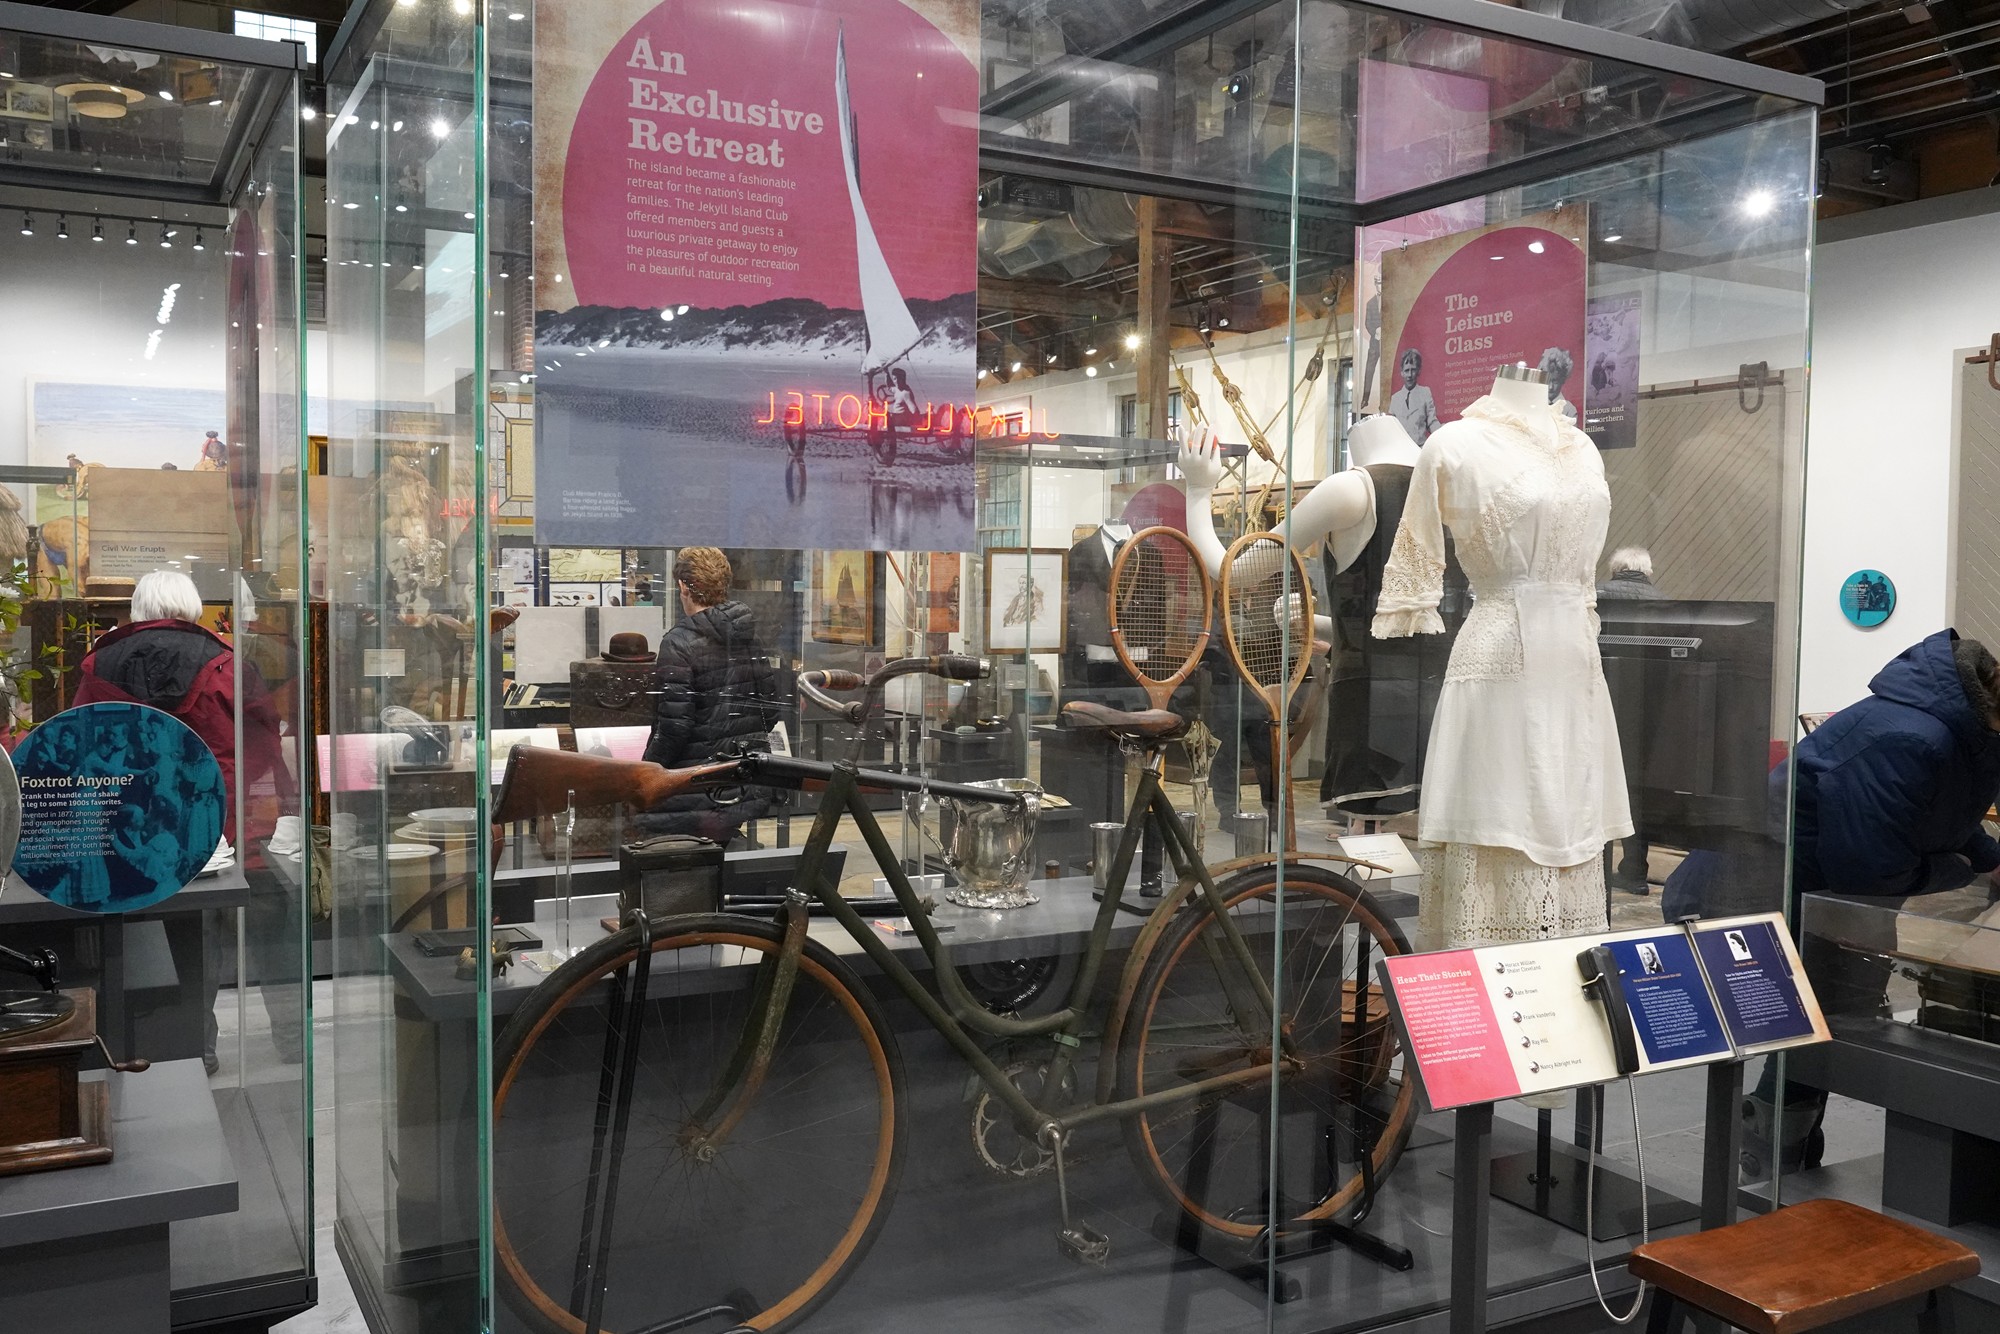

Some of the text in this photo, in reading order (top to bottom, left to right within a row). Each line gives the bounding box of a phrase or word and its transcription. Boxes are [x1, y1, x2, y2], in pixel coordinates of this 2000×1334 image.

[626, 38, 687, 75] An
[628, 77, 824, 134] Exclusive
[628, 118, 785, 168] Retreat
[627, 159, 796, 189] The island became a fashionable
[627, 177, 783, 206] retreat for the nation's leading
[627, 192, 788, 221] families. The Jekyll Island Club
[627, 211, 783, 237] offered members and guests a
[627, 227, 798, 257] luxurious private getaway to enjoy
[627, 245, 799, 271] the pleasures of outdoor recreation
[627, 261, 774, 287] in a beautiful natural setting.
[1445, 293, 1478, 312] The
[1445, 310, 1513, 333] Leisure
[1445, 335, 1493, 355] Class
[1611, 405, 1624, 413] and
[21, 774, 134, 789] Foxtrot Anyone?
[36, 819, 81, 827] gramophones
[21, 843, 68, 851] entertainment
[84, 834, 114, 842] providing
[21, 851, 60, 859] millionaires
[1418, 973, 1441, 982] Their
[1441, 969, 1471, 979] Stories
